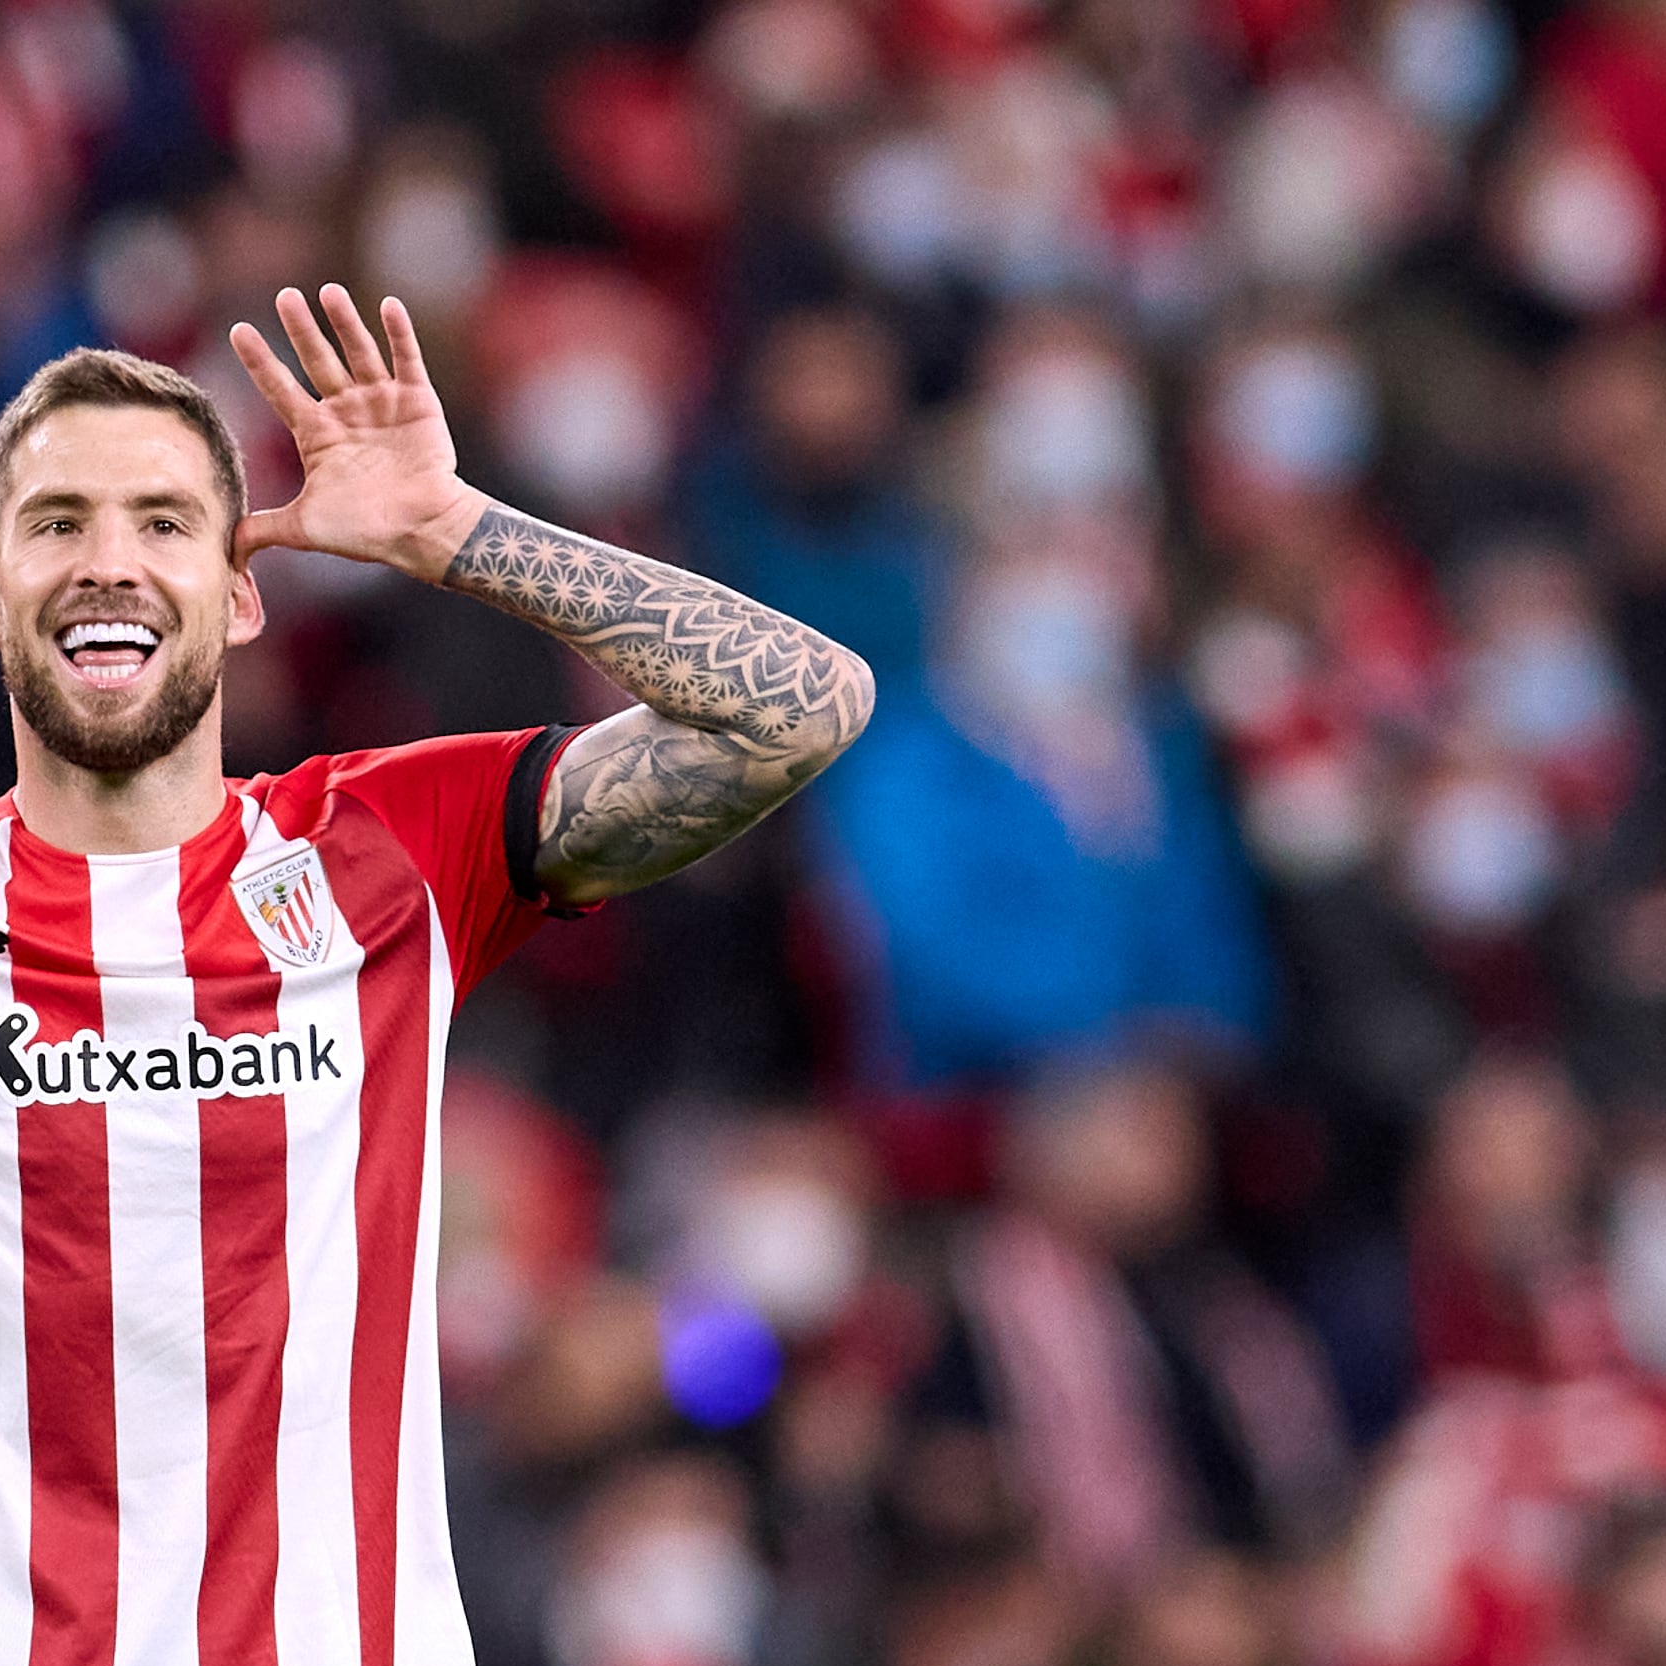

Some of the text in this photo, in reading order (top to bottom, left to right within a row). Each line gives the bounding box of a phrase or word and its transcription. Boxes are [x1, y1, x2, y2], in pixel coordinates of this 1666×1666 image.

[242, 857, 312, 894] ATHLETIC CLUB
[286, 929, 324, 961] BILBAO
